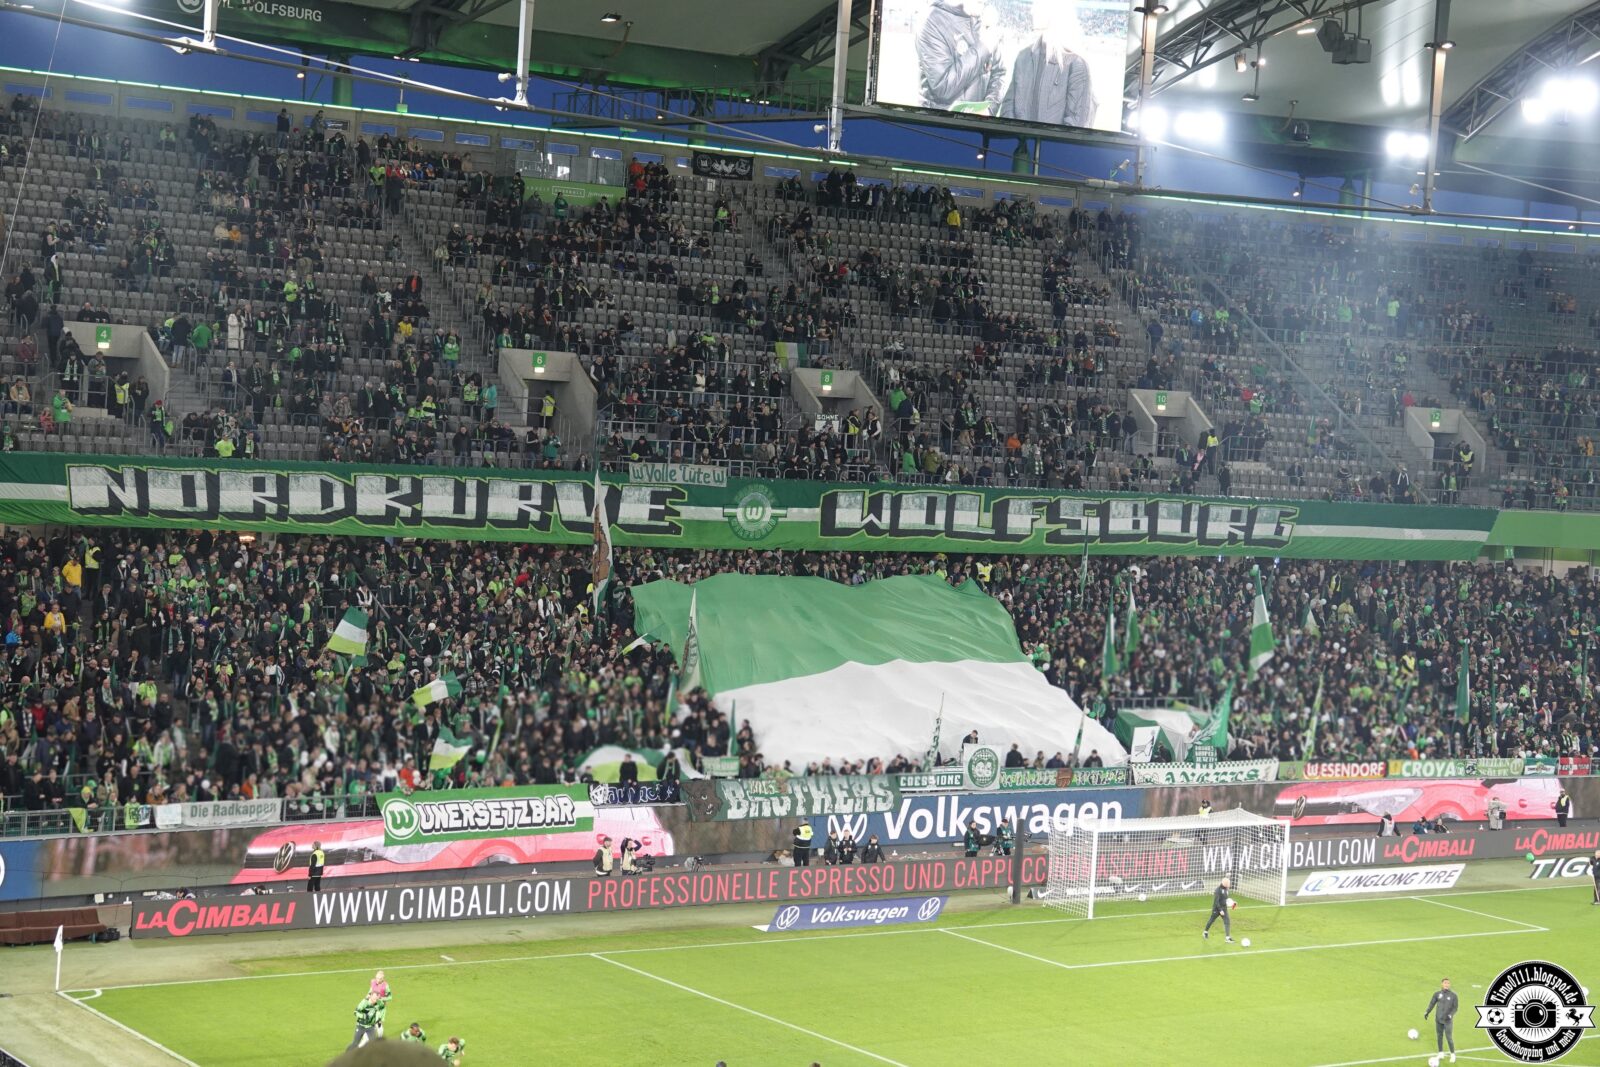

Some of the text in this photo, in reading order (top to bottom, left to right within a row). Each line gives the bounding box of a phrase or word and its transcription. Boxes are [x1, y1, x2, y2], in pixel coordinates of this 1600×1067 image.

[100, 330, 107, 339] 4
[536, 355, 543, 365] 6
[824, 374, 830, 383] 8
[645, 464, 677, 482] Volle
[679, 464, 711, 484] Tüte
[67, 464, 687, 537] NORDKURVE
[819, 489, 1300, 551] WOLFSBURG
[1402, 760, 1456, 778] CROYA
[190, 801, 277, 818] Die Radkappen
[416, 795, 576, 834] UNERSETZBAR
[884, 795, 1123, 841] Volkswagen
[1531, 856, 1593, 880] TIG
[587, 871, 780, 909] PROFESSIONELLE
[788, 865, 895, 898] ESPRESSO
[904, 861, 946, 891] UND
[1338, 869, 1460, 889] LINGLONG TIRE
[313, 880, 572, 926] WWW.CIMBALI.COM
[809, 903, 909, 924] Volkswagen
